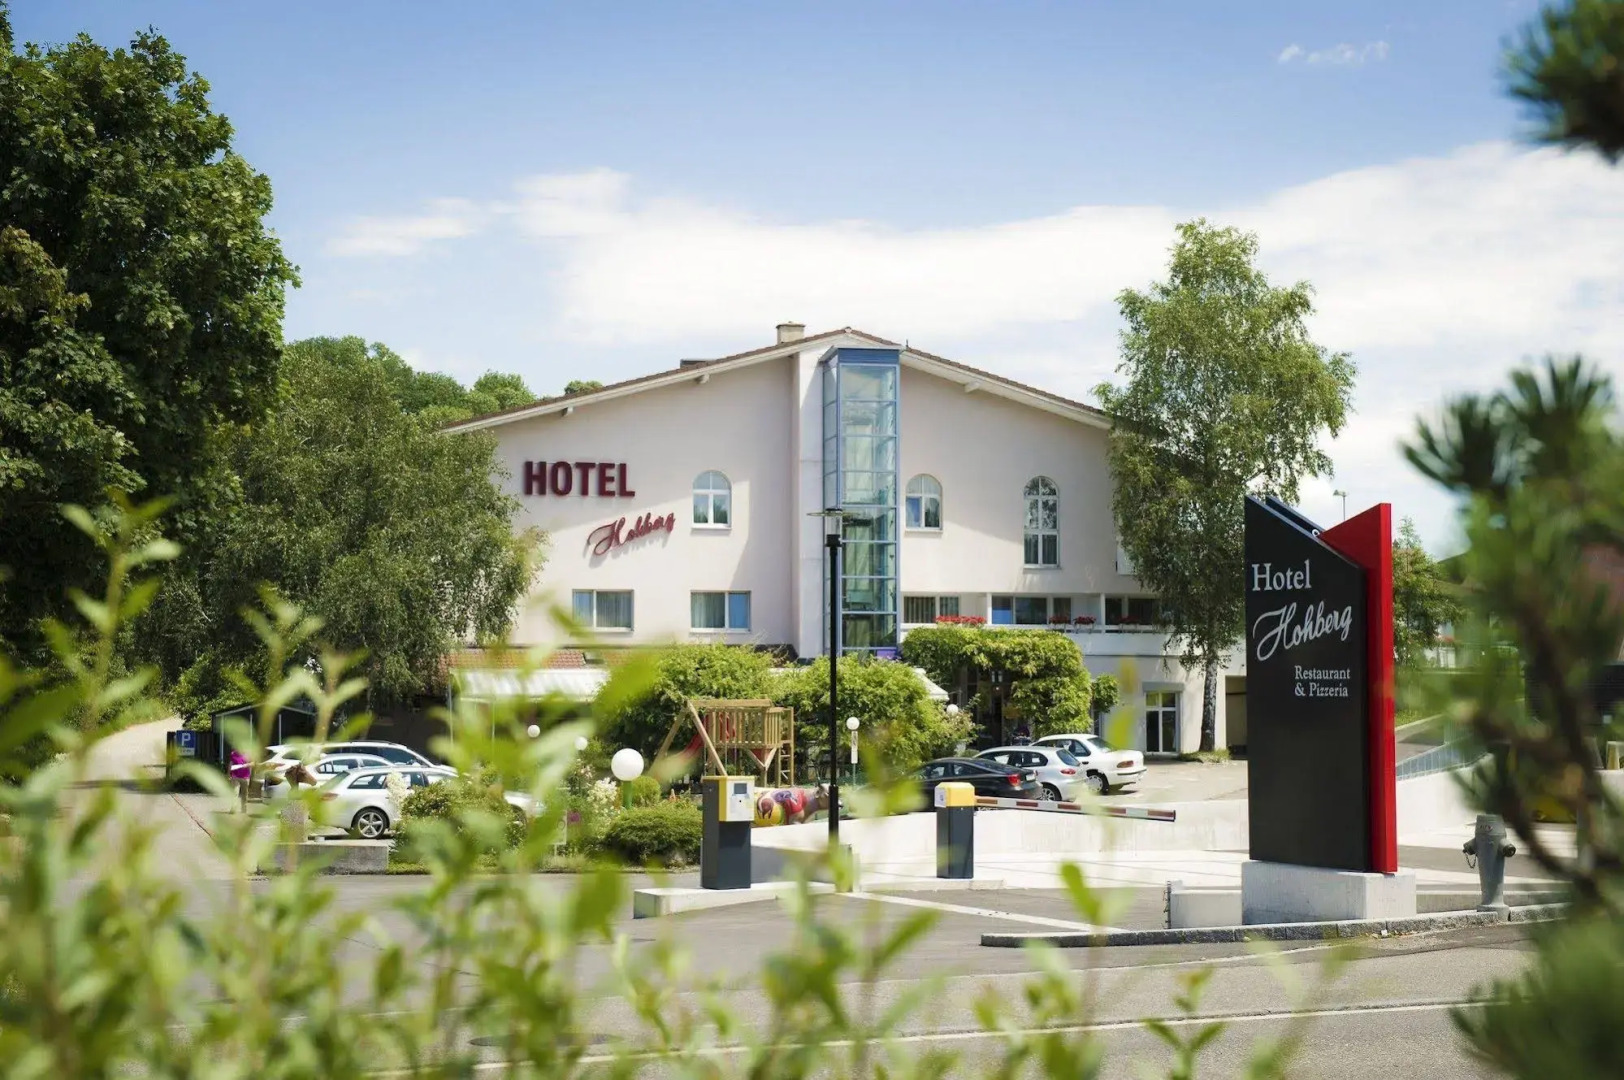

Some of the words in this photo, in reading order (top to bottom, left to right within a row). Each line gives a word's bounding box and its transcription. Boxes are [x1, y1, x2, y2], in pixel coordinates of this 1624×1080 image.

[524, 461, 635, 497] HOTEL
[1252, 559, 1312, 591] Hotel
[1252, 601, 1353, 661] Hohberg
[1294, 665, 1351, 680] Restaurant
[1294, 682, 1306, 697] &
[1309, 682, 1349, 697] Pizzeria
[181, 732, 191, 747] P
